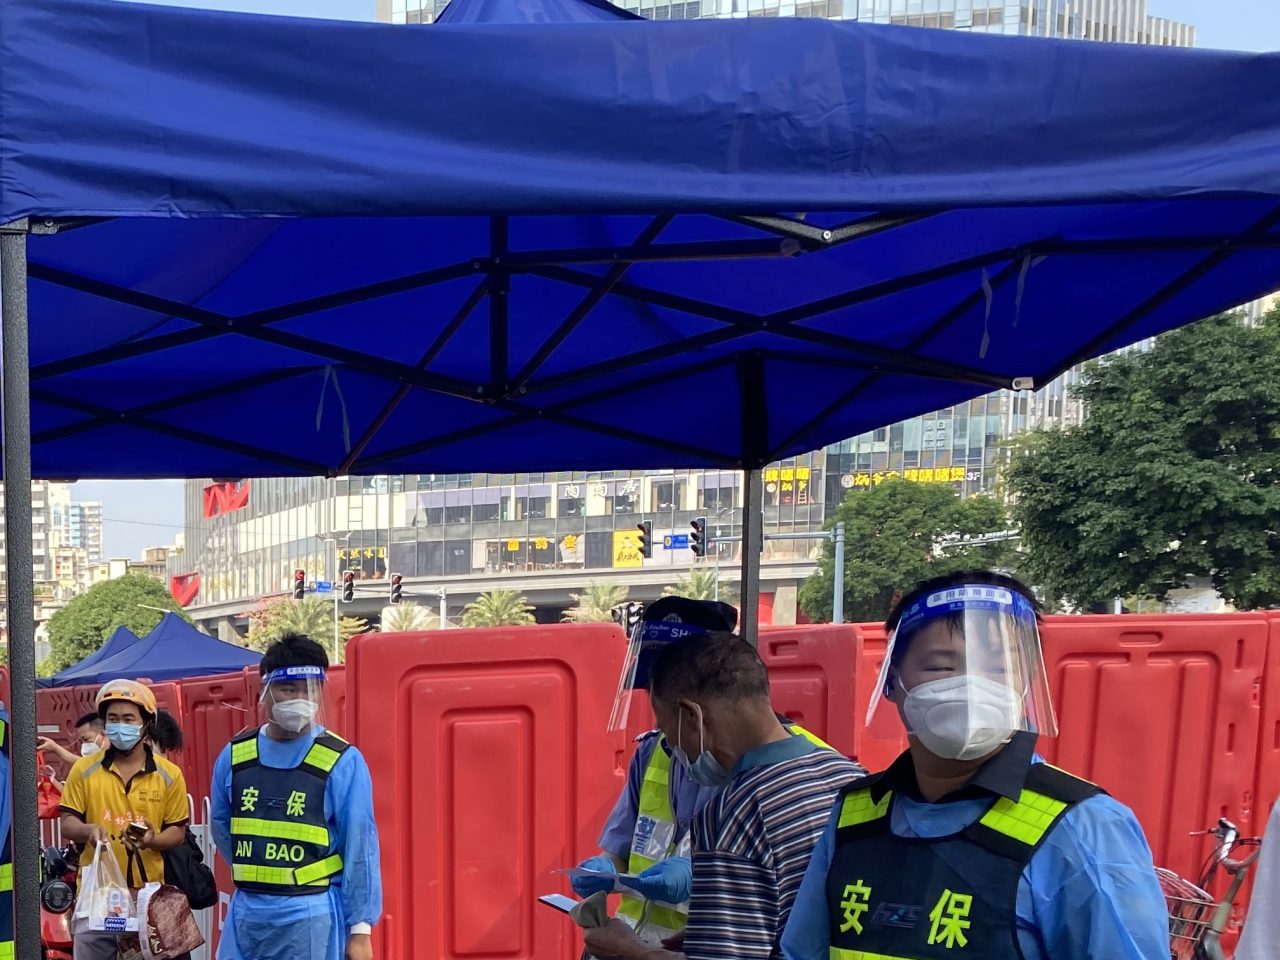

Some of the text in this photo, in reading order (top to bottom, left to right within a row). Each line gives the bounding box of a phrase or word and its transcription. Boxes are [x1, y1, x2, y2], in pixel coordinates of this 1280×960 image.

[241, 786, 307, 817] 安保
[235, 840, 305, 863] AN BAO
[838, 879, 974, 949] 安保
